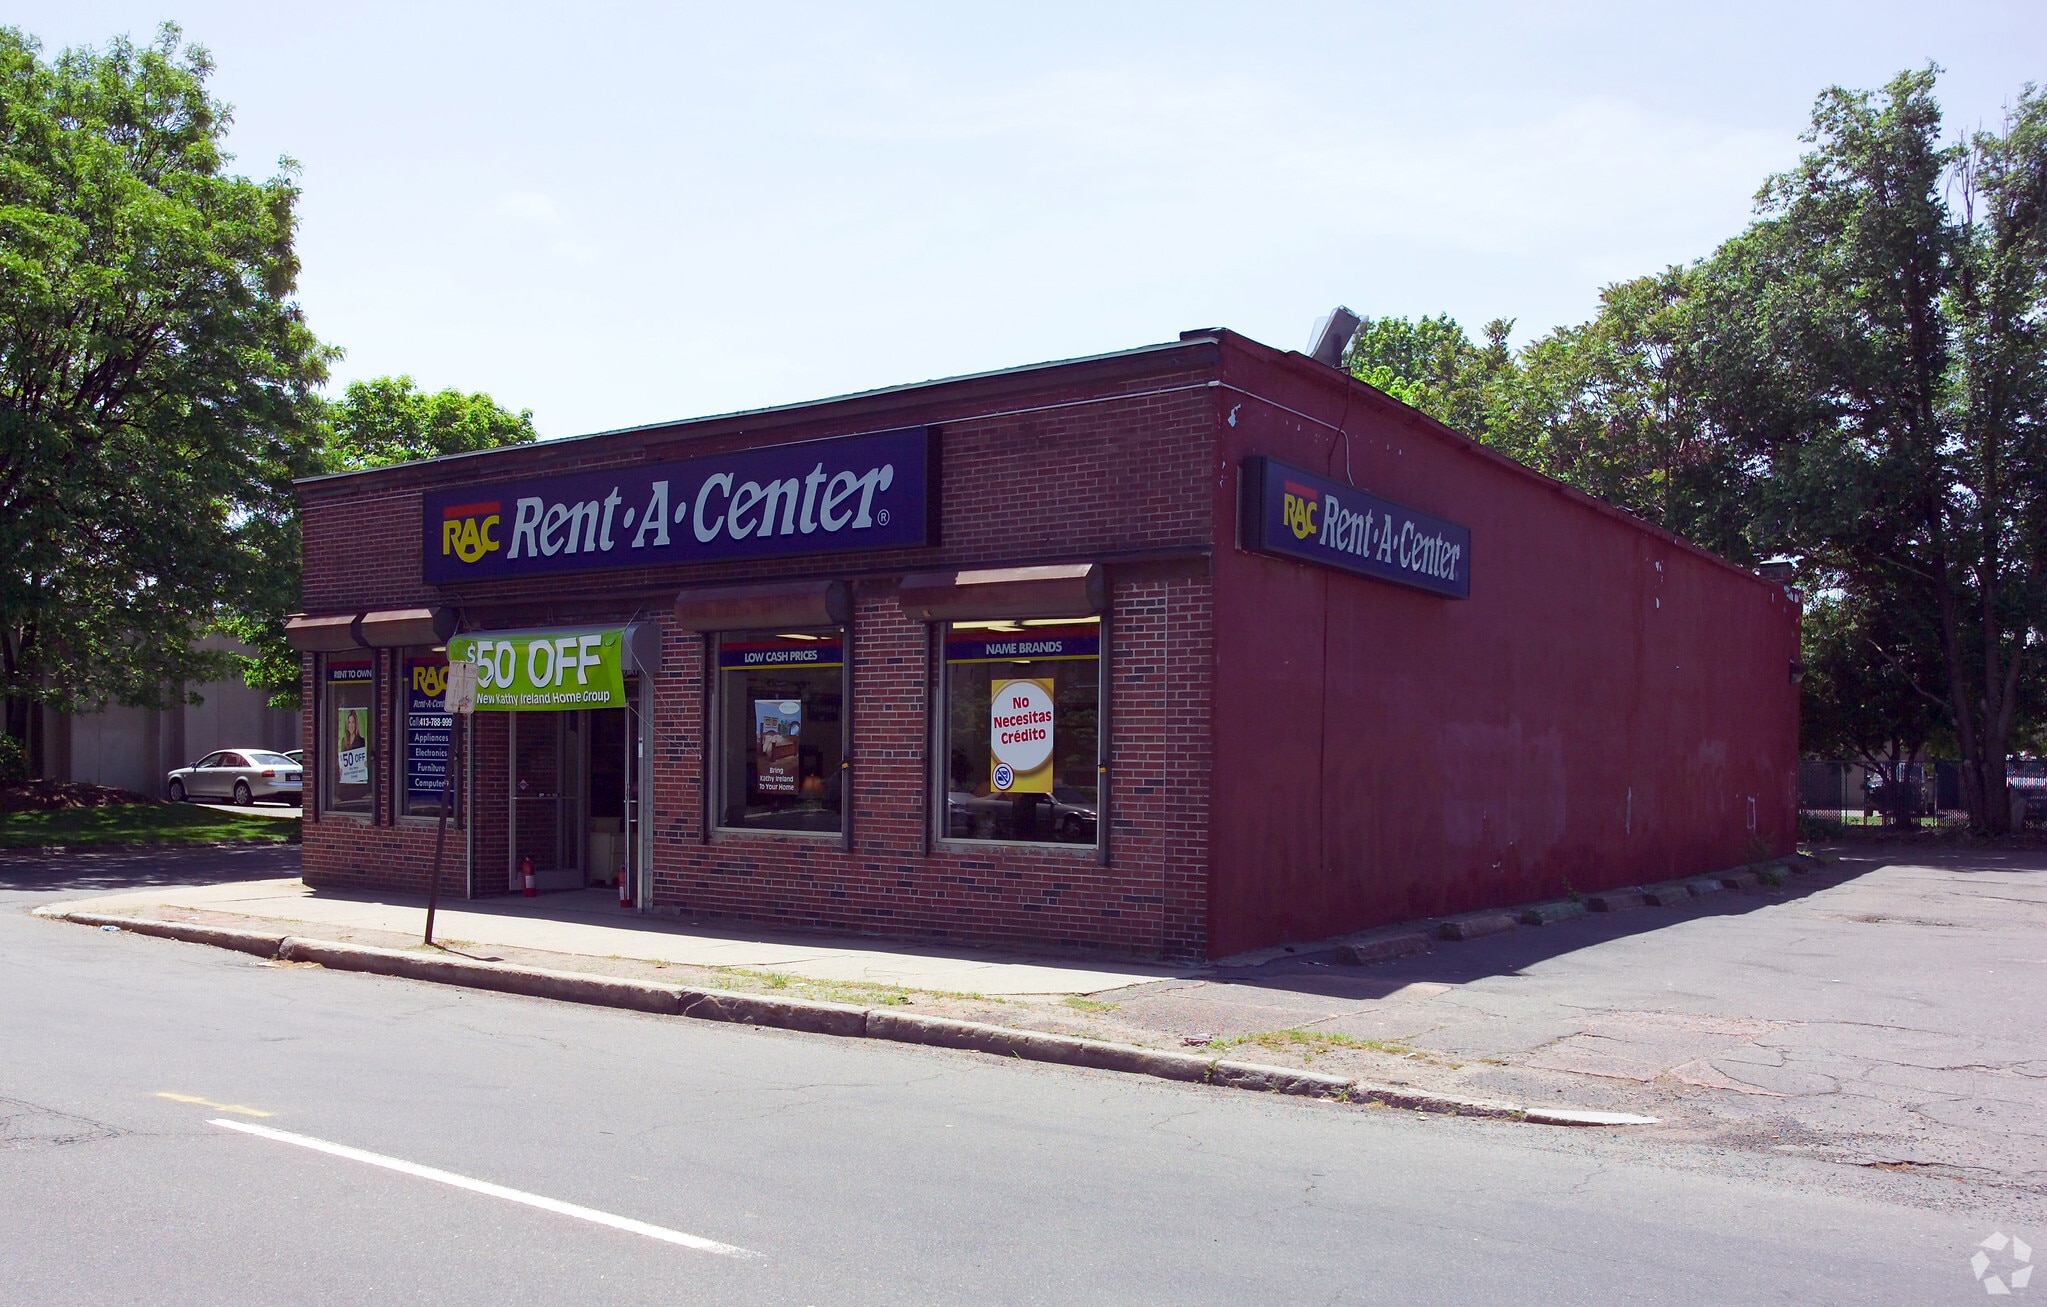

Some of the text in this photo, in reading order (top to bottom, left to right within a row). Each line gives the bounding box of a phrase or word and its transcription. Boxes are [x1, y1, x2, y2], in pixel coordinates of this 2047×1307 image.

[1283, 493, 1317, 540] RAC
[443, 515, 500, 563] RAC
[985, 641, 1063, 655] NAME BRANDS
[467, 635, 602, 689] $50 OFF
[744, 650, 818, 663] LOW CASH PRICES
[333, 669, 372, 679] RENT TO OWN
[476, 690, 610, 706] New Kathy Ireland Home Group
[1012, 697, 1030, 710] No
[993, 710, 1052, 729] Necesitas
[414, 733, 449, 743] Appliances
[1001, 728, 1047, 745] Crédito
[354, 752, 366, 763] OFF
[415, 747, 448, 757] Electronics
[417, 762, 446, 772] Furniture
[769, 767, 784, 775] Bring
[414, 778, 446, 789] Computer
[778, 783, 795, 791] Home
